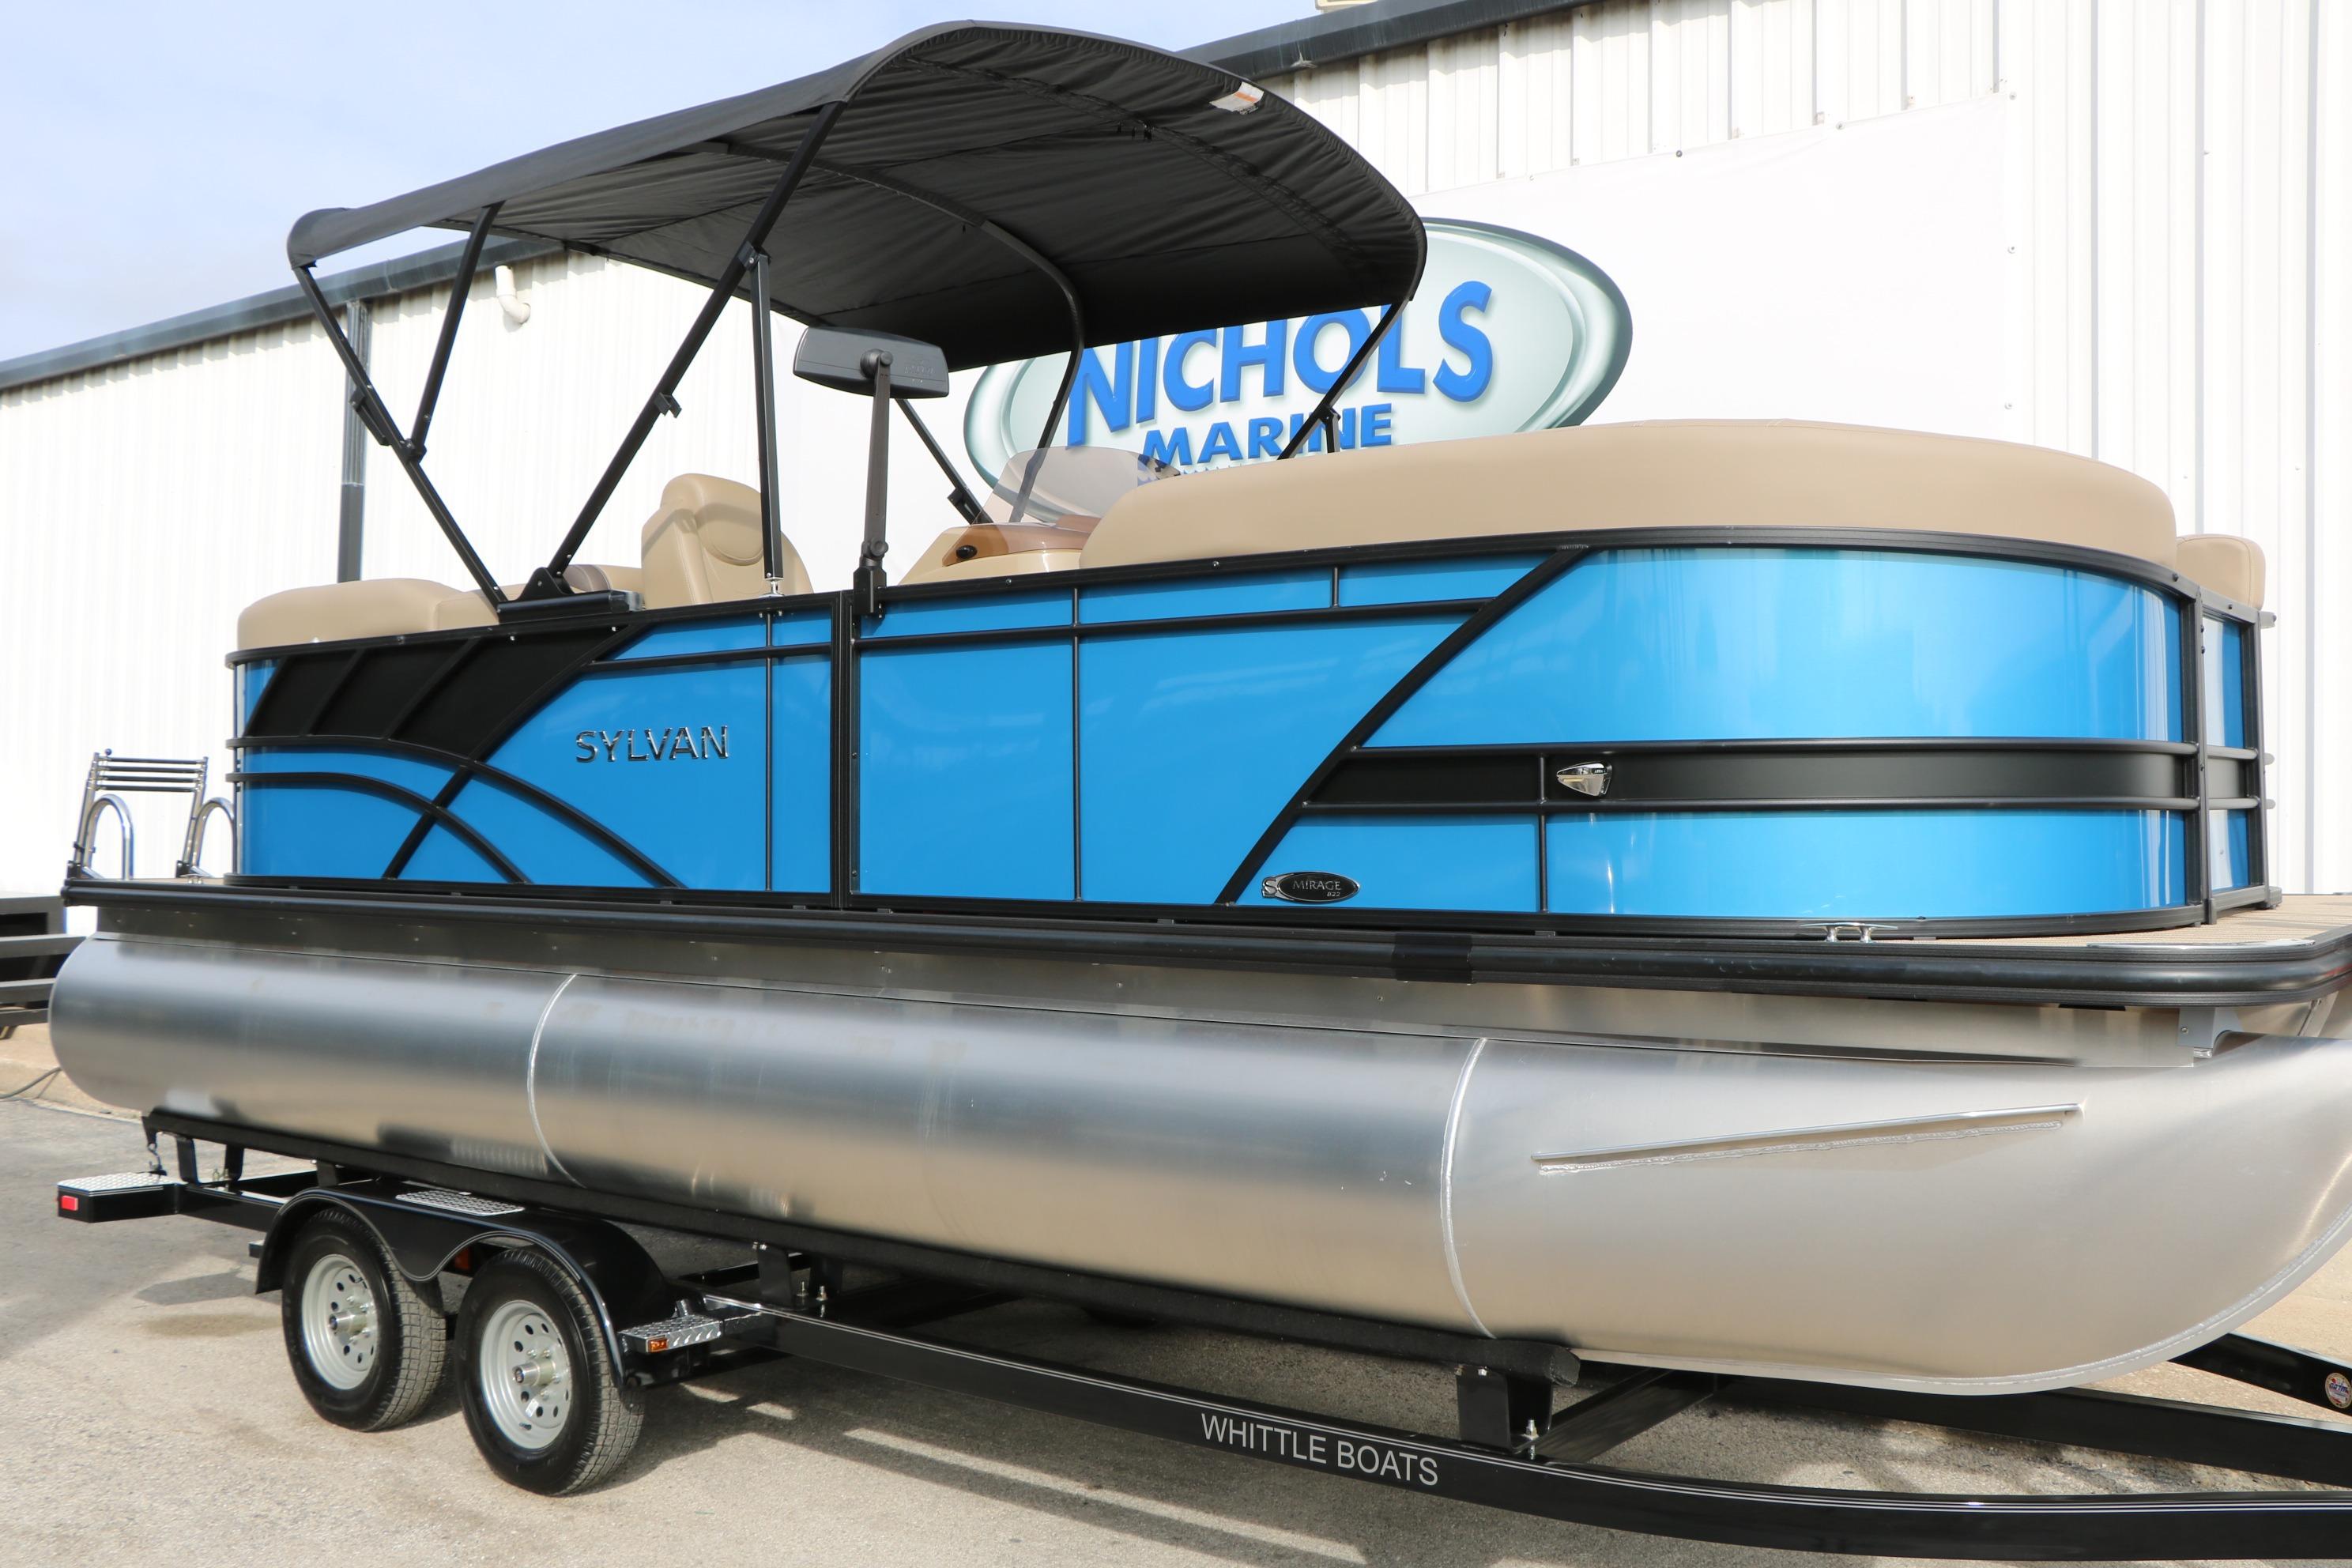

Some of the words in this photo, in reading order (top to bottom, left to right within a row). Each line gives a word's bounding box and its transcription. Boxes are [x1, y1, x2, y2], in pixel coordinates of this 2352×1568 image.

[1065, 281, 1493, 450] NICHOLS
[1142, 403, 1392, 466] MARINE
[575, 725, 730, 763] SYLVAN
[1292, 880, 1342, 891] MIRAGE
[1201, 1413, 1327, 1464] WHITTLE
[1337, 1440, 1438, 1486] BOATS
